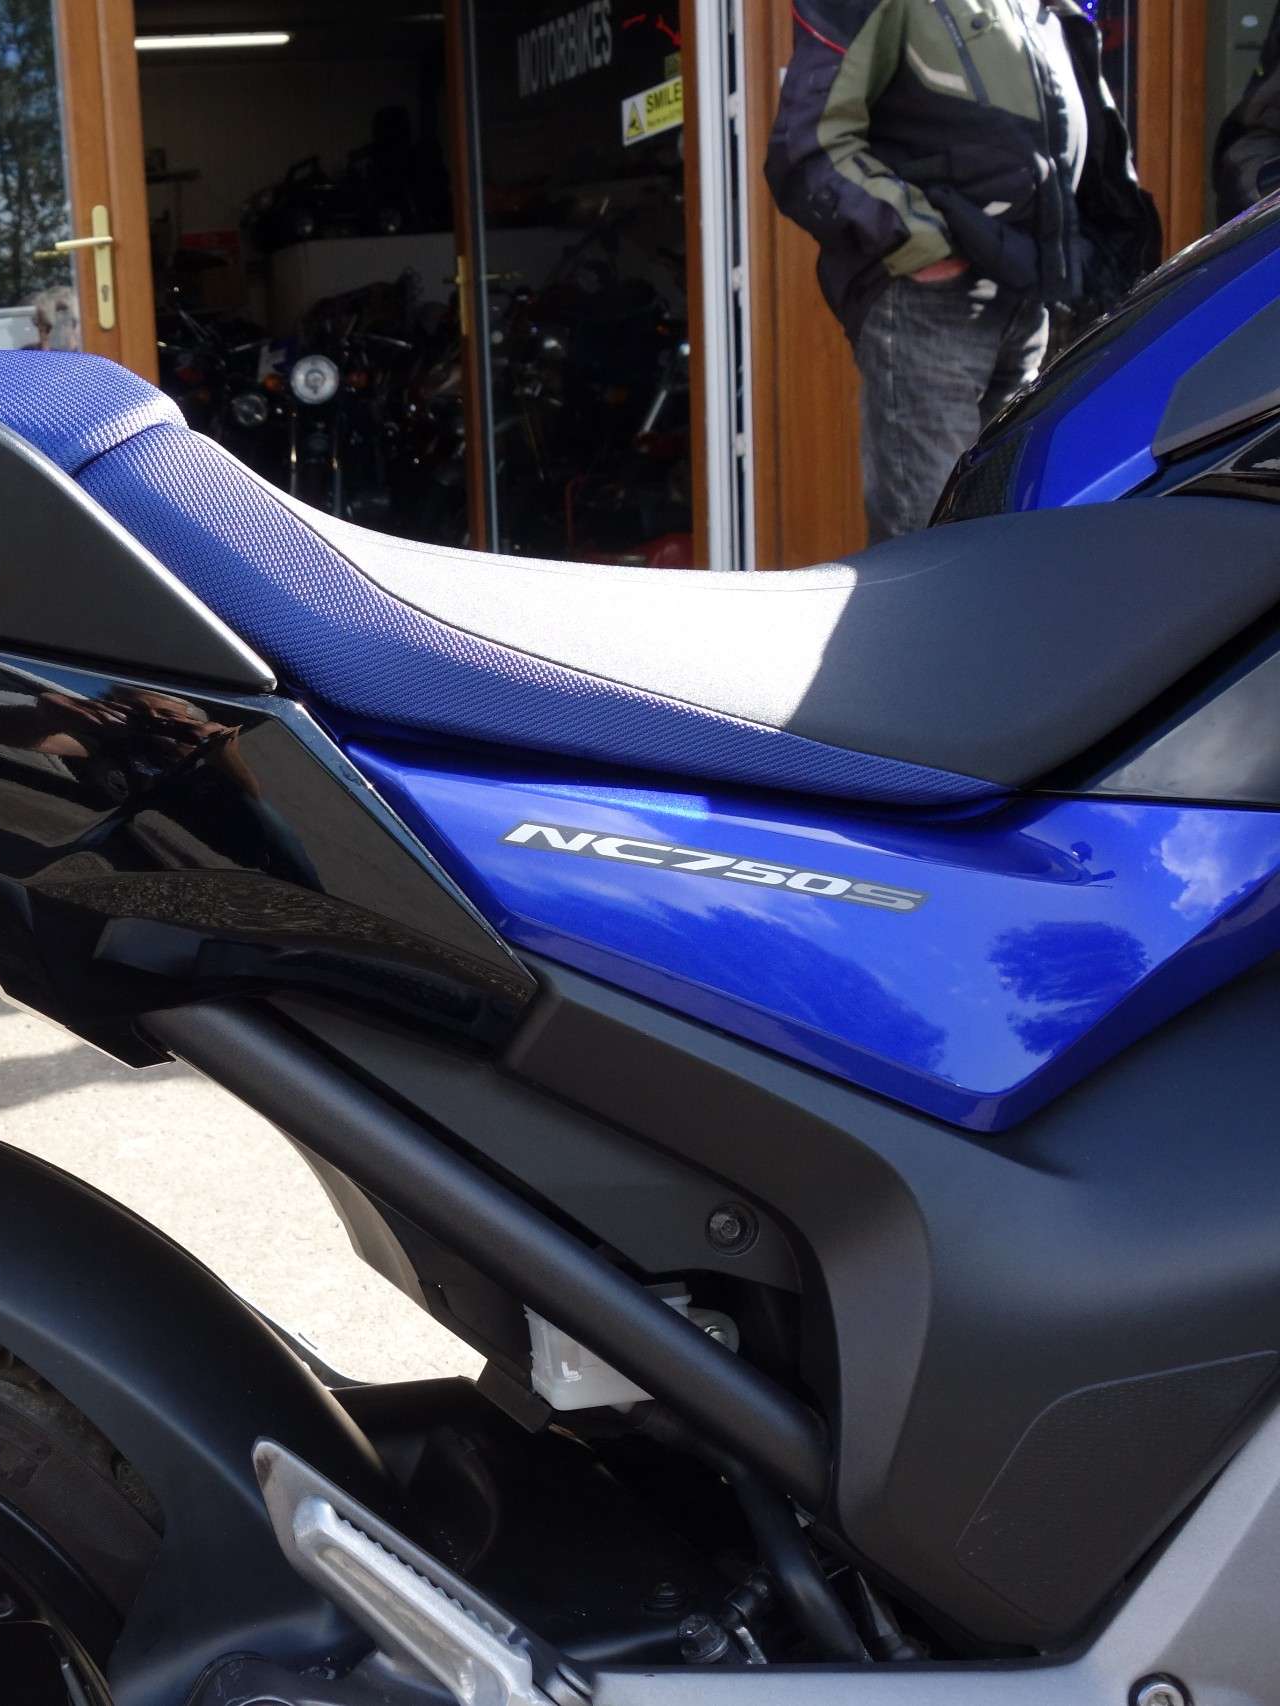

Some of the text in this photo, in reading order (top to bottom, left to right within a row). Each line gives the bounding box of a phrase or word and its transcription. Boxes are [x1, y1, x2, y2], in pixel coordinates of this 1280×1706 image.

[517, 0, 612, 98] MOTORBIKES
[646, 82, 681, 113] SMILE
[504, 823, 926, 911] NC750S
